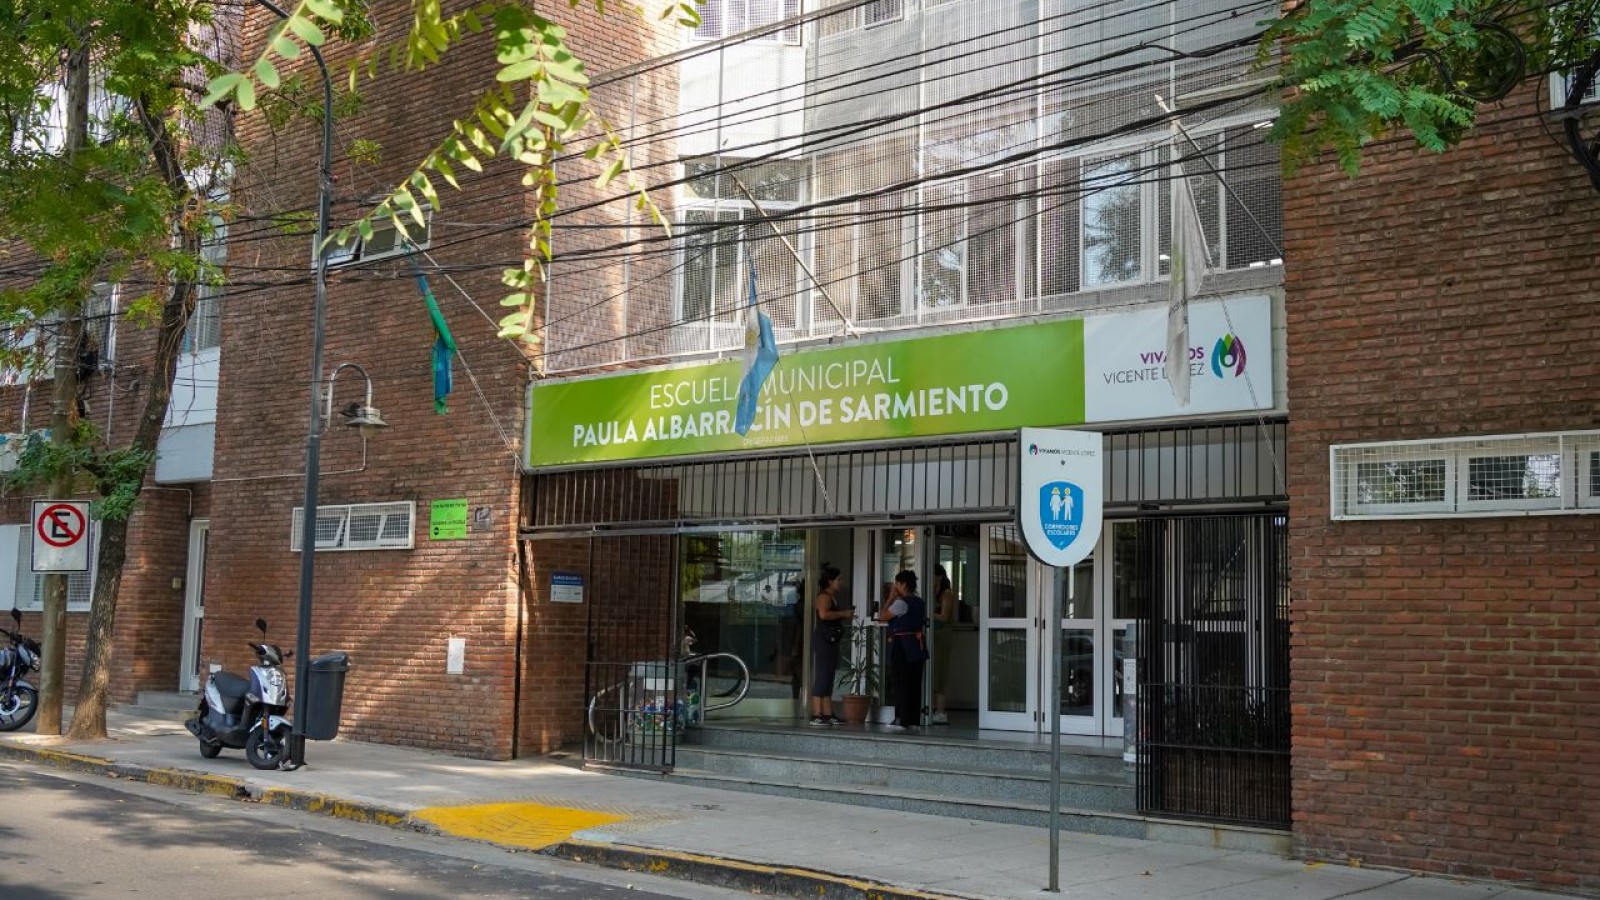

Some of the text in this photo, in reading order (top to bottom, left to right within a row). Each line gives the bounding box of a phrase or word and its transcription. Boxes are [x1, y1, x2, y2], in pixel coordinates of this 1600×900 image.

[1103, 363, 1205, 385] VICENTE LEZ
[650, 377, 743, 410] ESCUEL
[573, 419, 637, 447] PAULA
[799, 398, 833, 427] DE
[839, 381, 1009, 423] SARMIENTO
